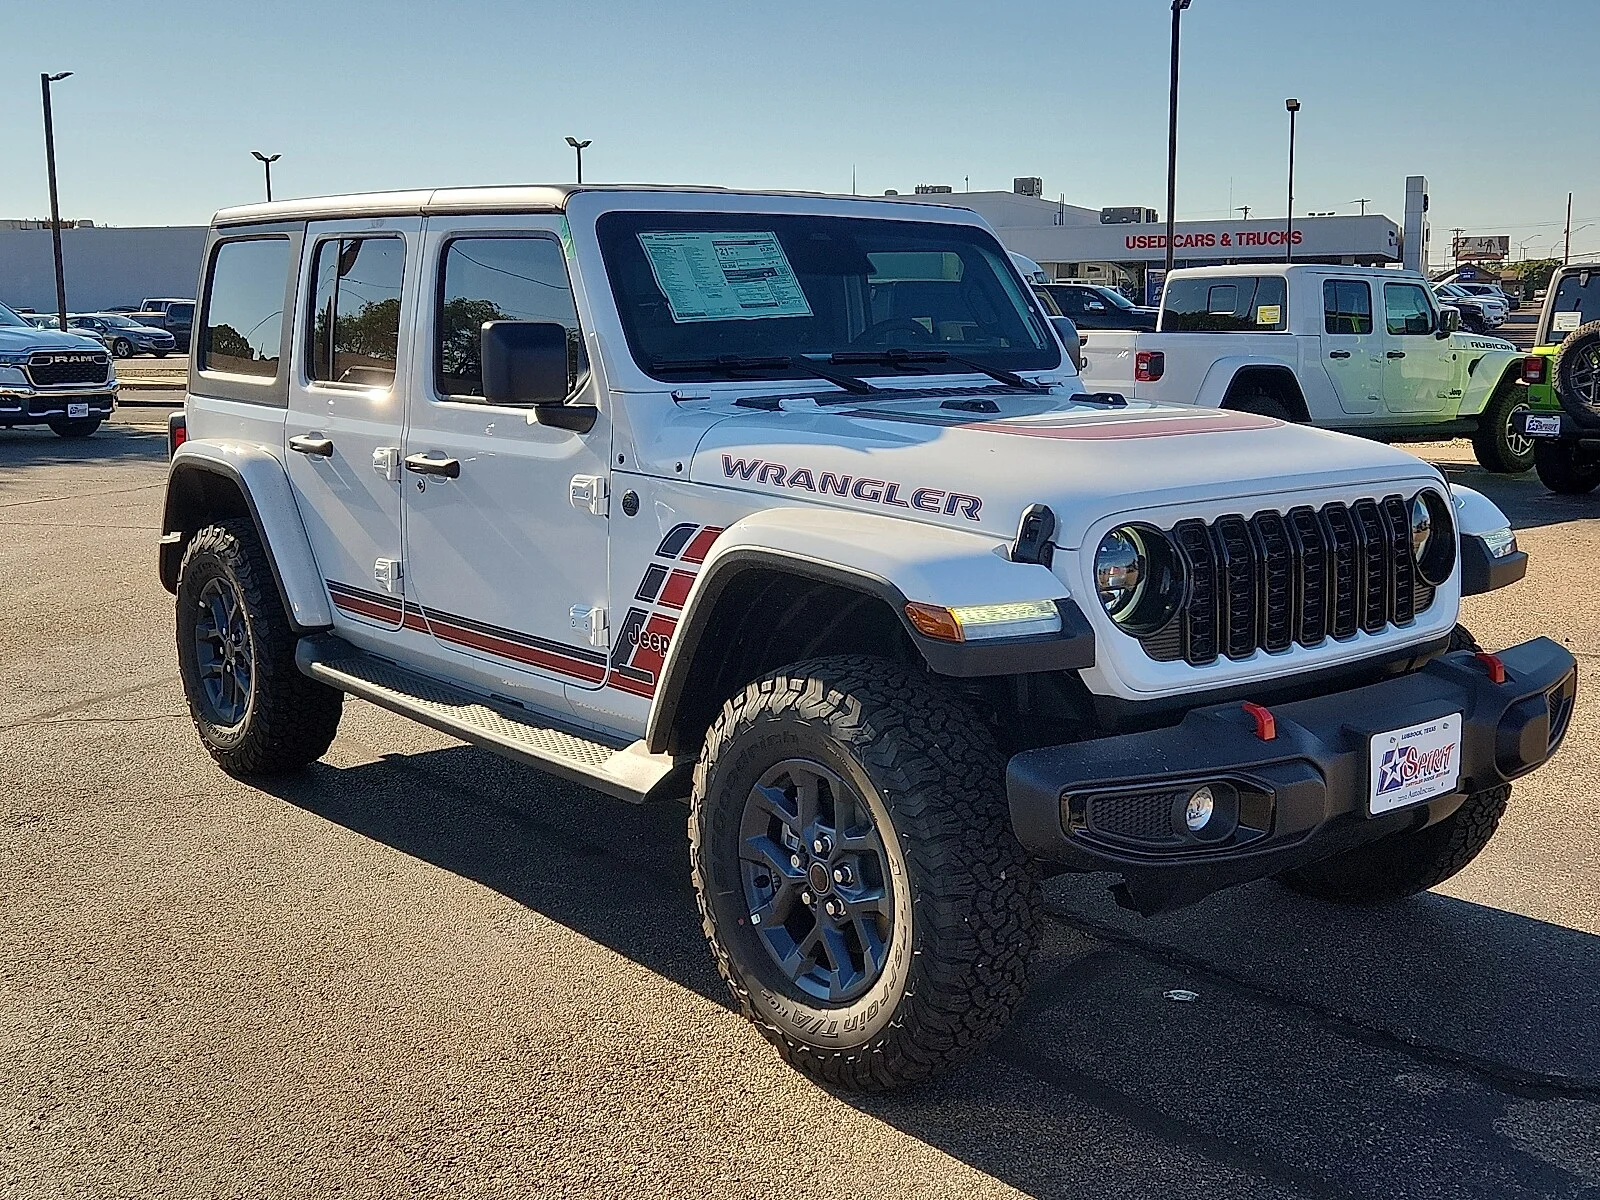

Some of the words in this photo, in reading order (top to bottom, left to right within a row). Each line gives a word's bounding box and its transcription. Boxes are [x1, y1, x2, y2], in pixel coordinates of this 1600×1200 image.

[1125, 234, 1167, 249] USED
[1173, 232, 1215, 248] CARS
[1220, 232, 1231, 246] &
[1235, 231, 1303, 246] TRUCKS
[1470, 341, 1514, 351] RUBICON
[1449, 388, 1461, 396] Jeep
[721, 453, 983, 522] WRANGLER
[628, 623, 671, 658] Jeep
[1424, 726, 1437, 734] TEXAS
[1403, 742, 1456, 779] SPIRIT
[790, 1008, 839, 1038] T/A
